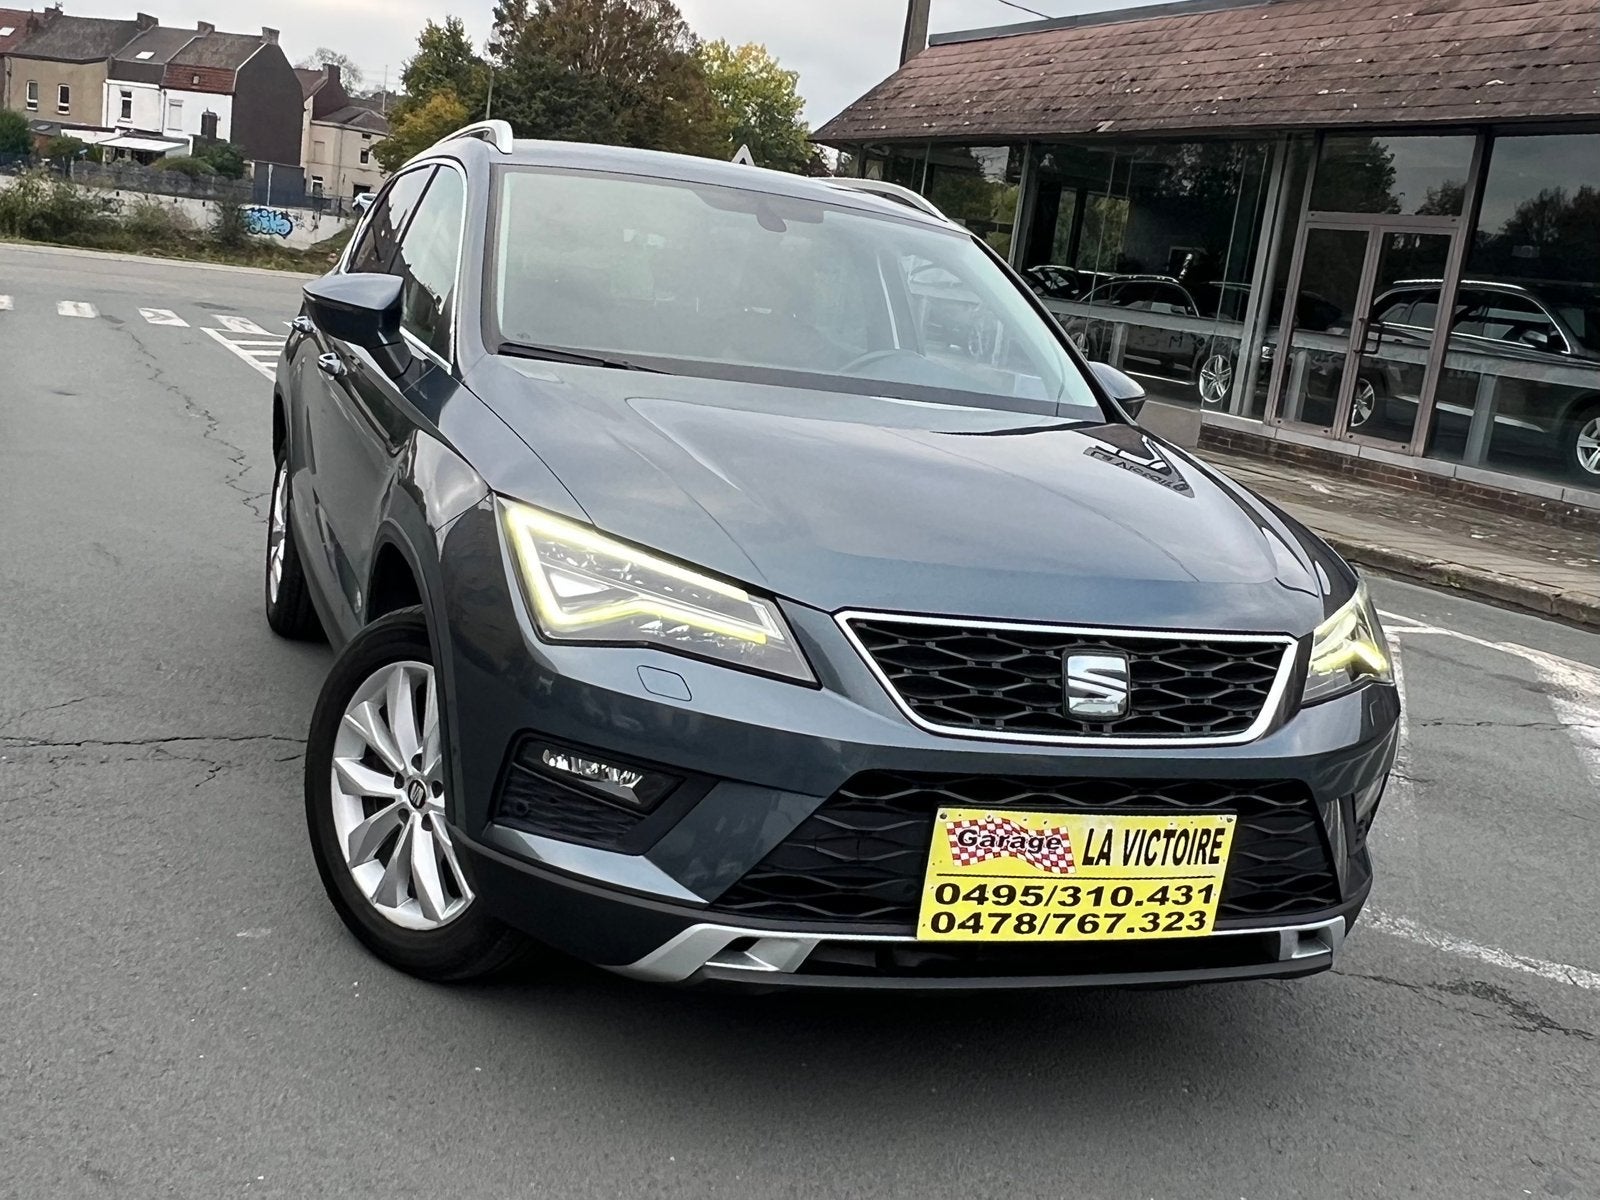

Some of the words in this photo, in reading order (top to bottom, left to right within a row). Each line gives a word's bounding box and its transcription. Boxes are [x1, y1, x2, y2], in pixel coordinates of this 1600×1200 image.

[956, 828, 1063, 855] Garage
[1081, 827, 1112, 867] LA
[1122, 827, 1226, 867] VICTOIRE
[934, 883, 1214, 907] 0495/310.431
[930, 910, 1207, 935] 0478/767.323
